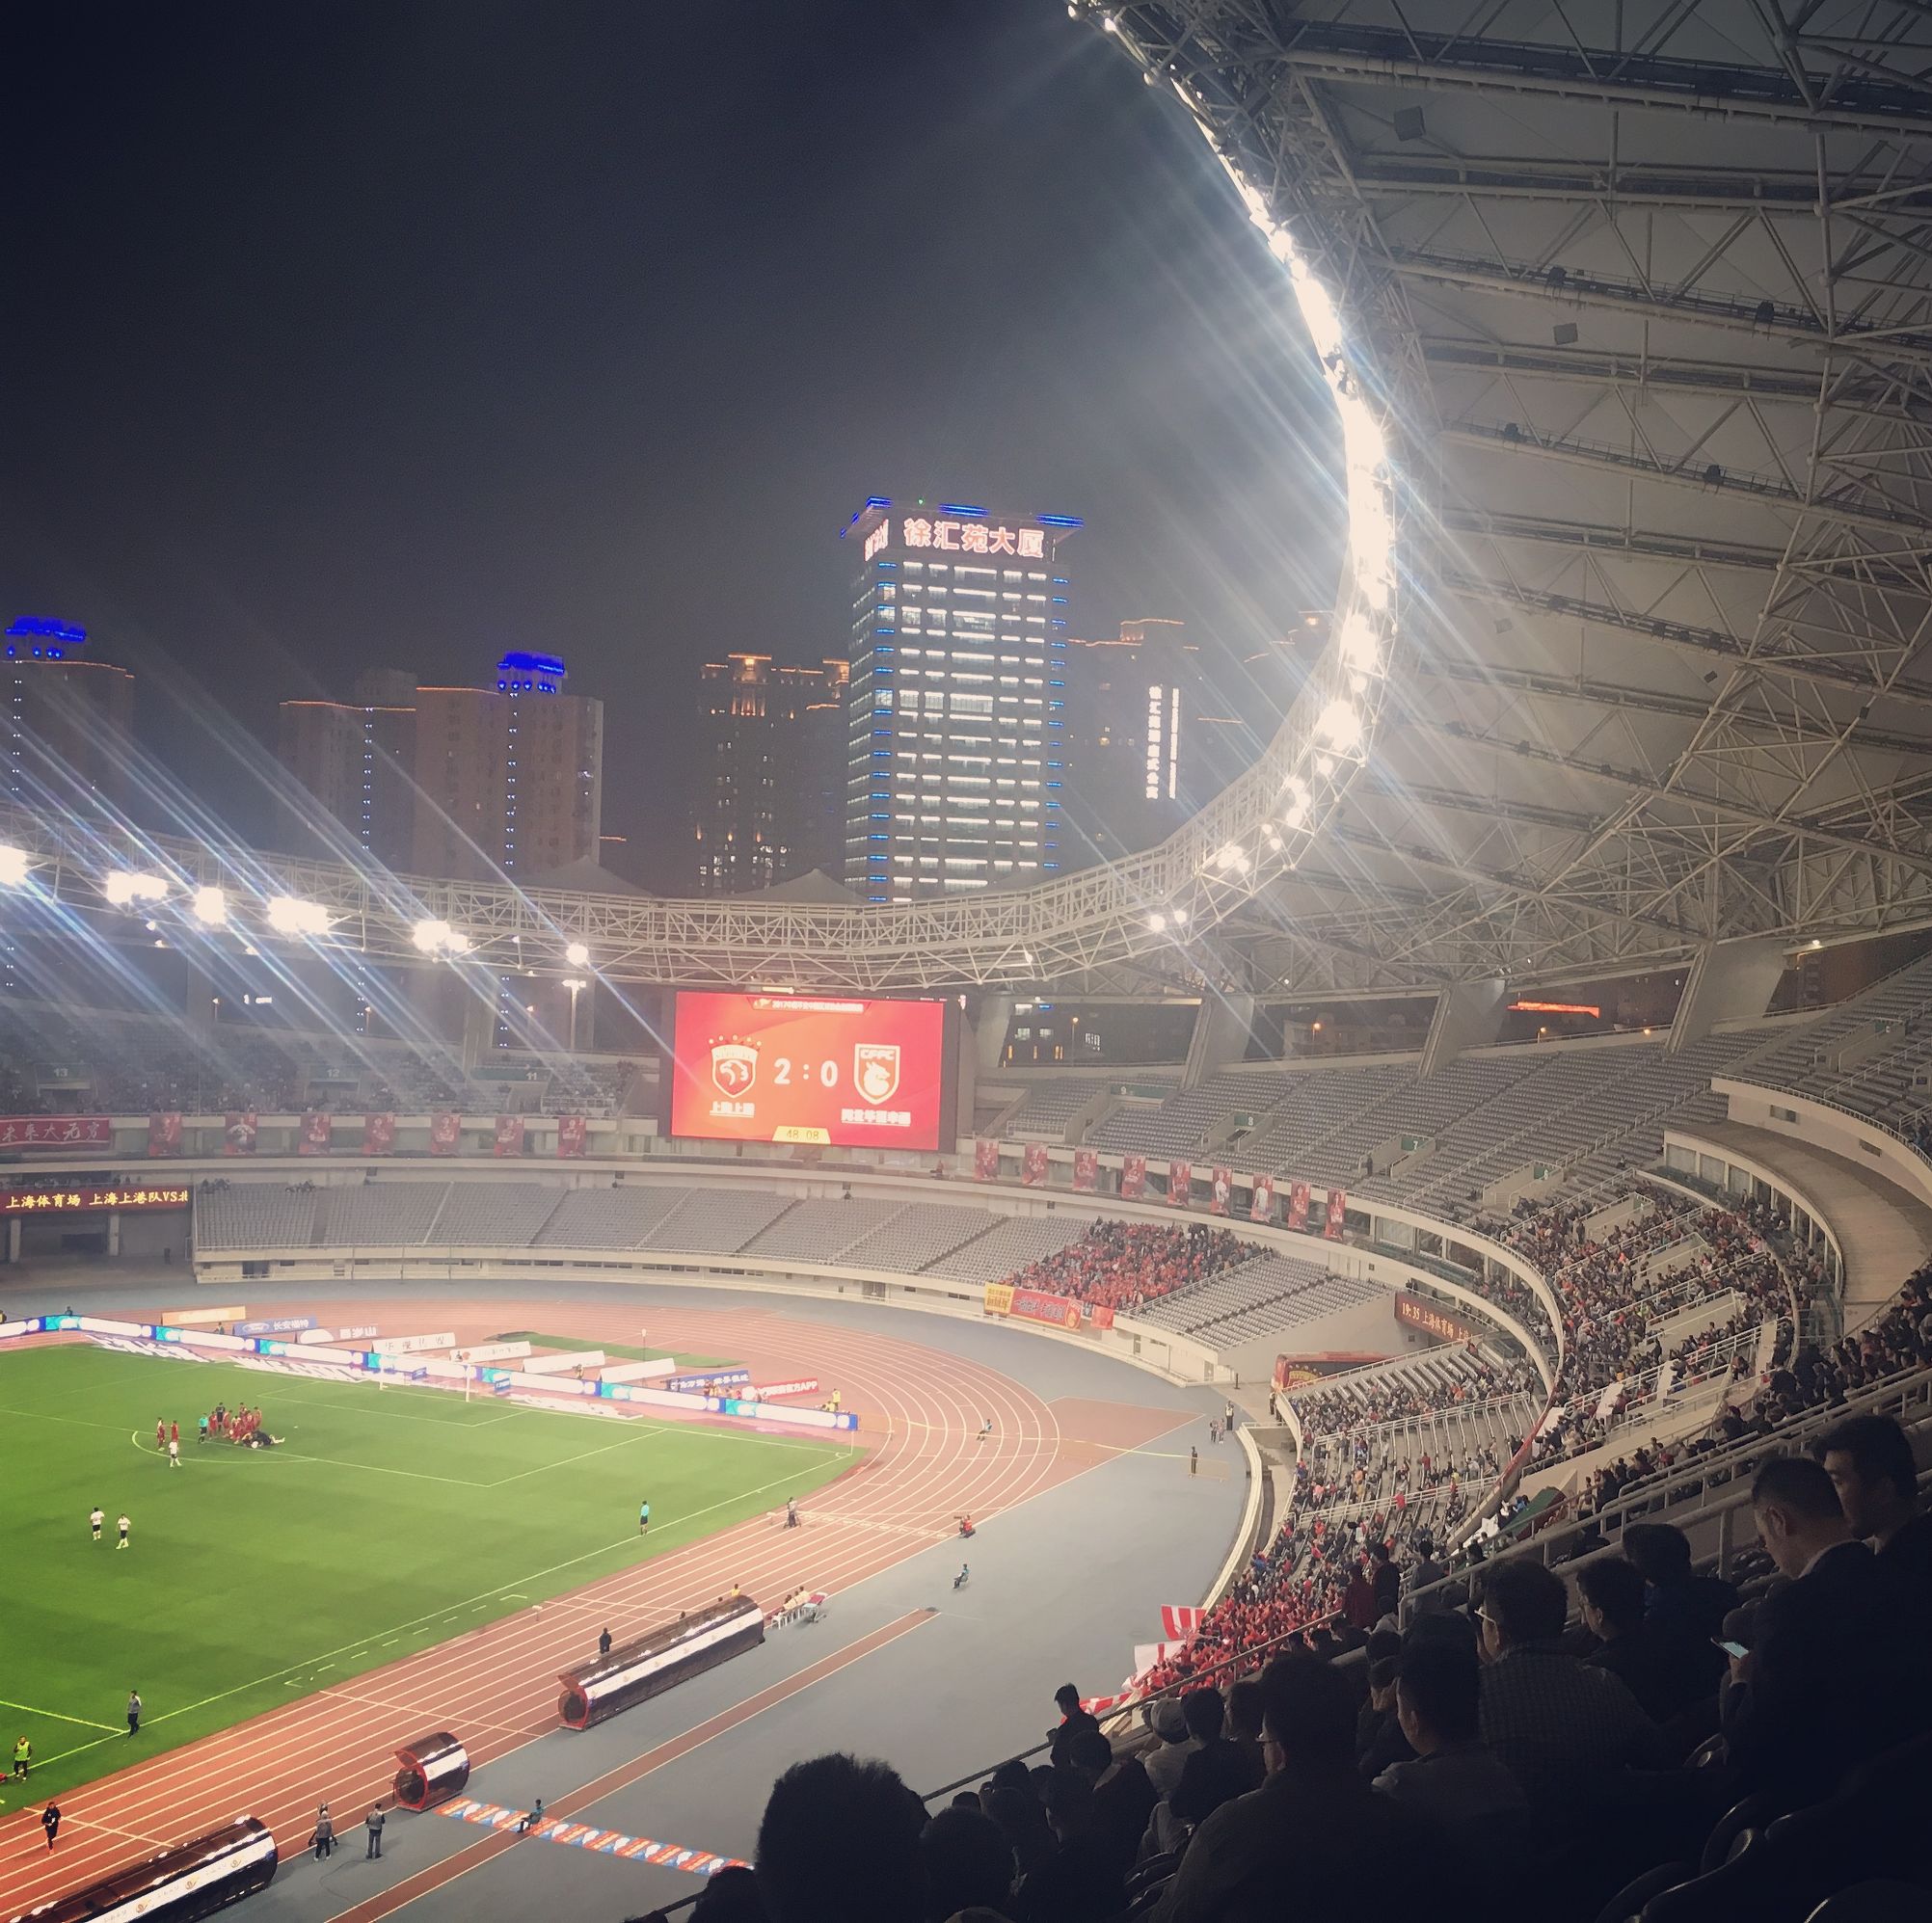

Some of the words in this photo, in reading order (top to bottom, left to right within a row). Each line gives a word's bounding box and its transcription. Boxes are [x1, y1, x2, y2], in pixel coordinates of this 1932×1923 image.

[903, 518, 1045, 558] 徐汇苑大厦
[773, 1058, 792, 1084] 2
[820, 1060, 839, 1087] 0
[1248, 1116, 1254, 1126] 8
[6, 1193, 81, 1210] 上海体育场
[1421, 1311, 1454, 1339] 上海体育场
